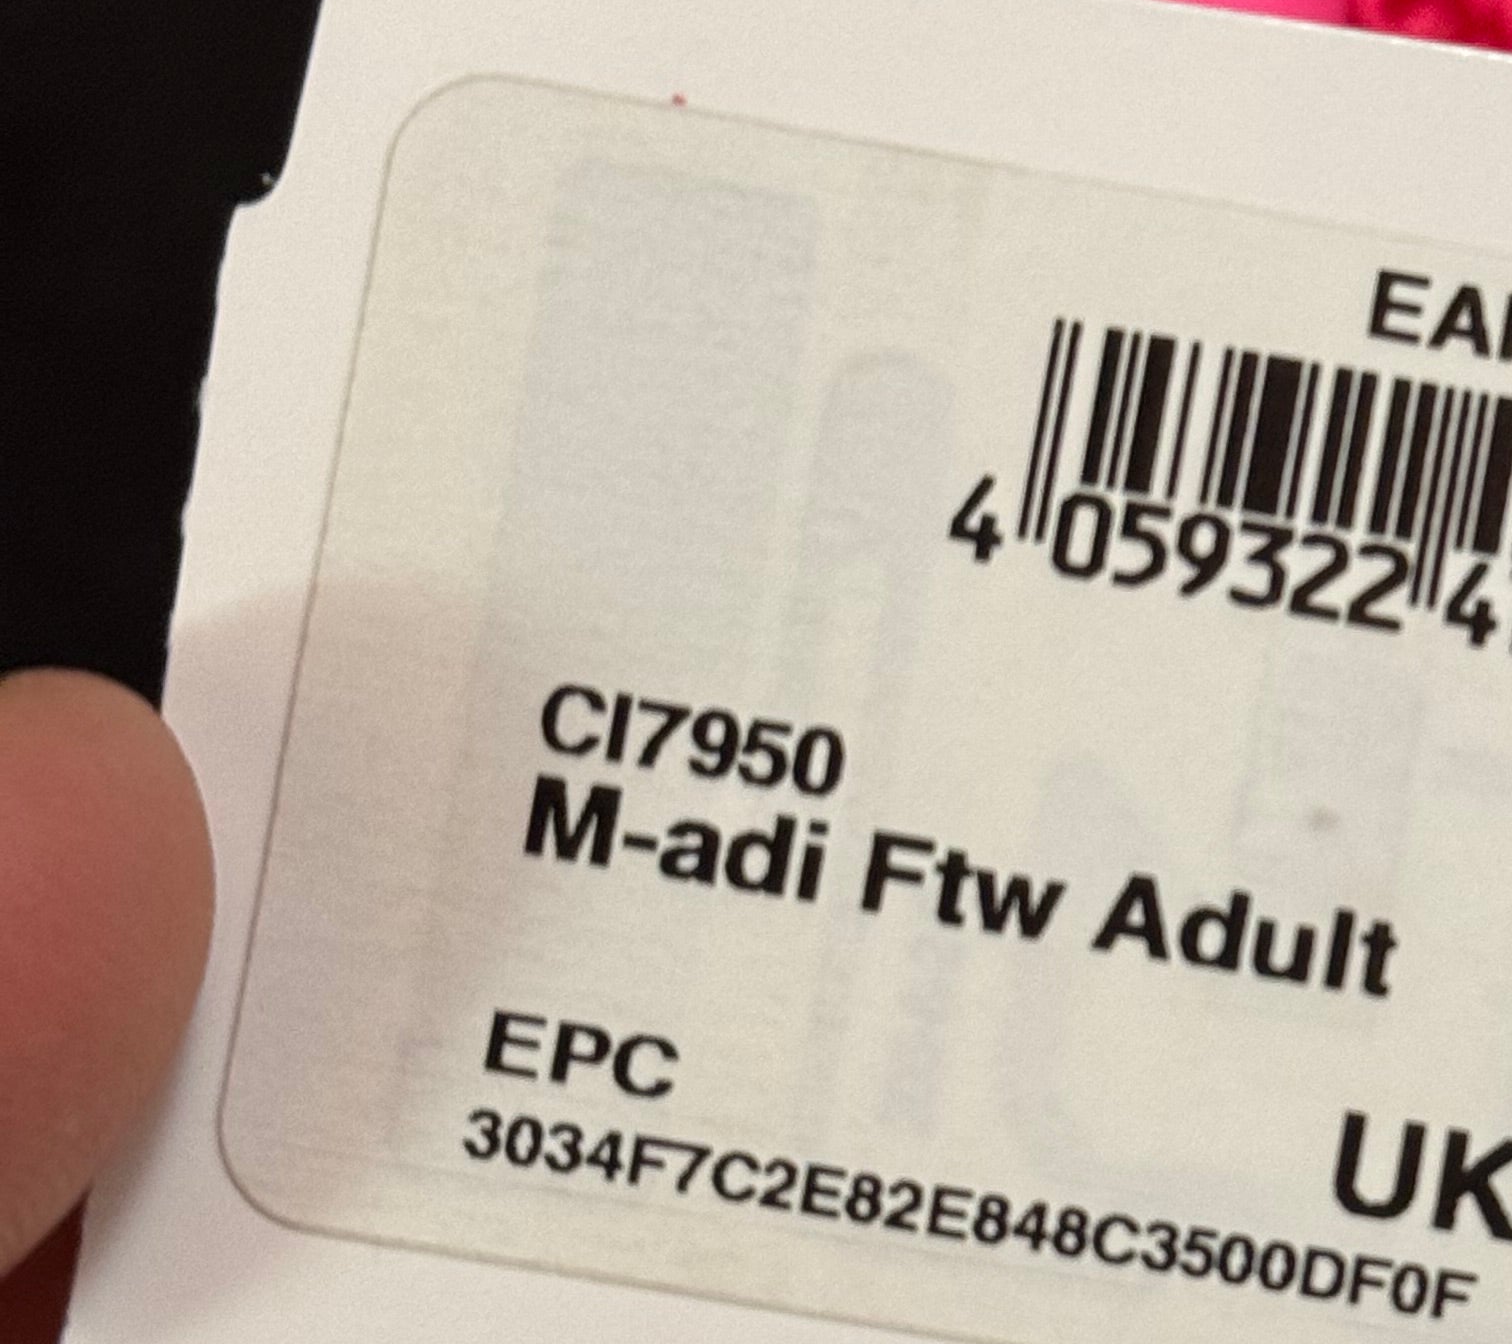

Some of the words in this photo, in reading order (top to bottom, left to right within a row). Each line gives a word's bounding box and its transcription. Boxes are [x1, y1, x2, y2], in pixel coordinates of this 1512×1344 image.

[947, 475, 1003, 564] 4
[539, 683, 846, 798] CI7950
[522, 772, 830, 903] M-adi
[860, 830, 1067, 941] Ftw
[1090, 873, 1399, 998] Adult
[482, 1009, 681, 1100] EPC
[461, 1107, 1480, 1321] 3034F7C2E82E848C3500DF0F
